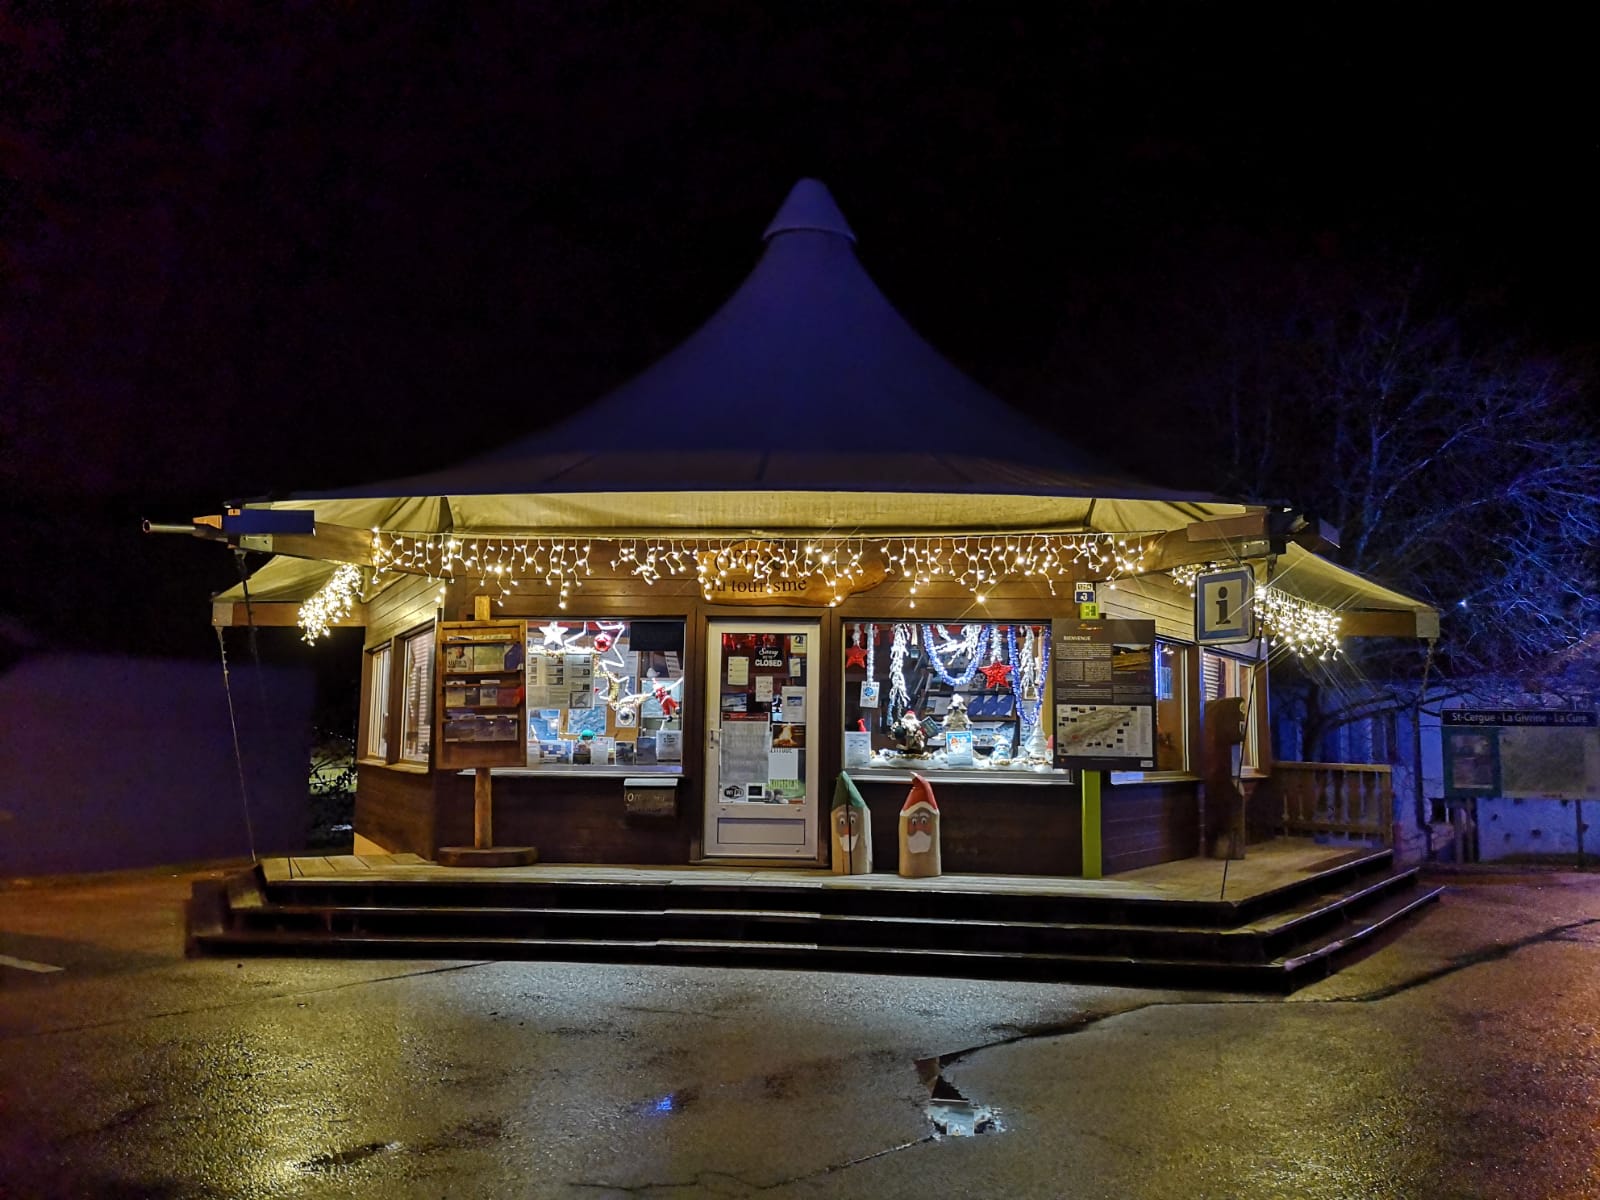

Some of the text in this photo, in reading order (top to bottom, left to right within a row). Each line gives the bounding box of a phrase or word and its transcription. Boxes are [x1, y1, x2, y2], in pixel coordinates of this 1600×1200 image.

[732, 578, 808, 593] toursme
[754, 658, 783, 667] CLOSED
[1451, 712, 1496, 724] St-Cergue
[1502, 712, 1513, 722] La
[1514, 712, 1547, 722] Givrine
[1554, 713, 1565, 723] La
